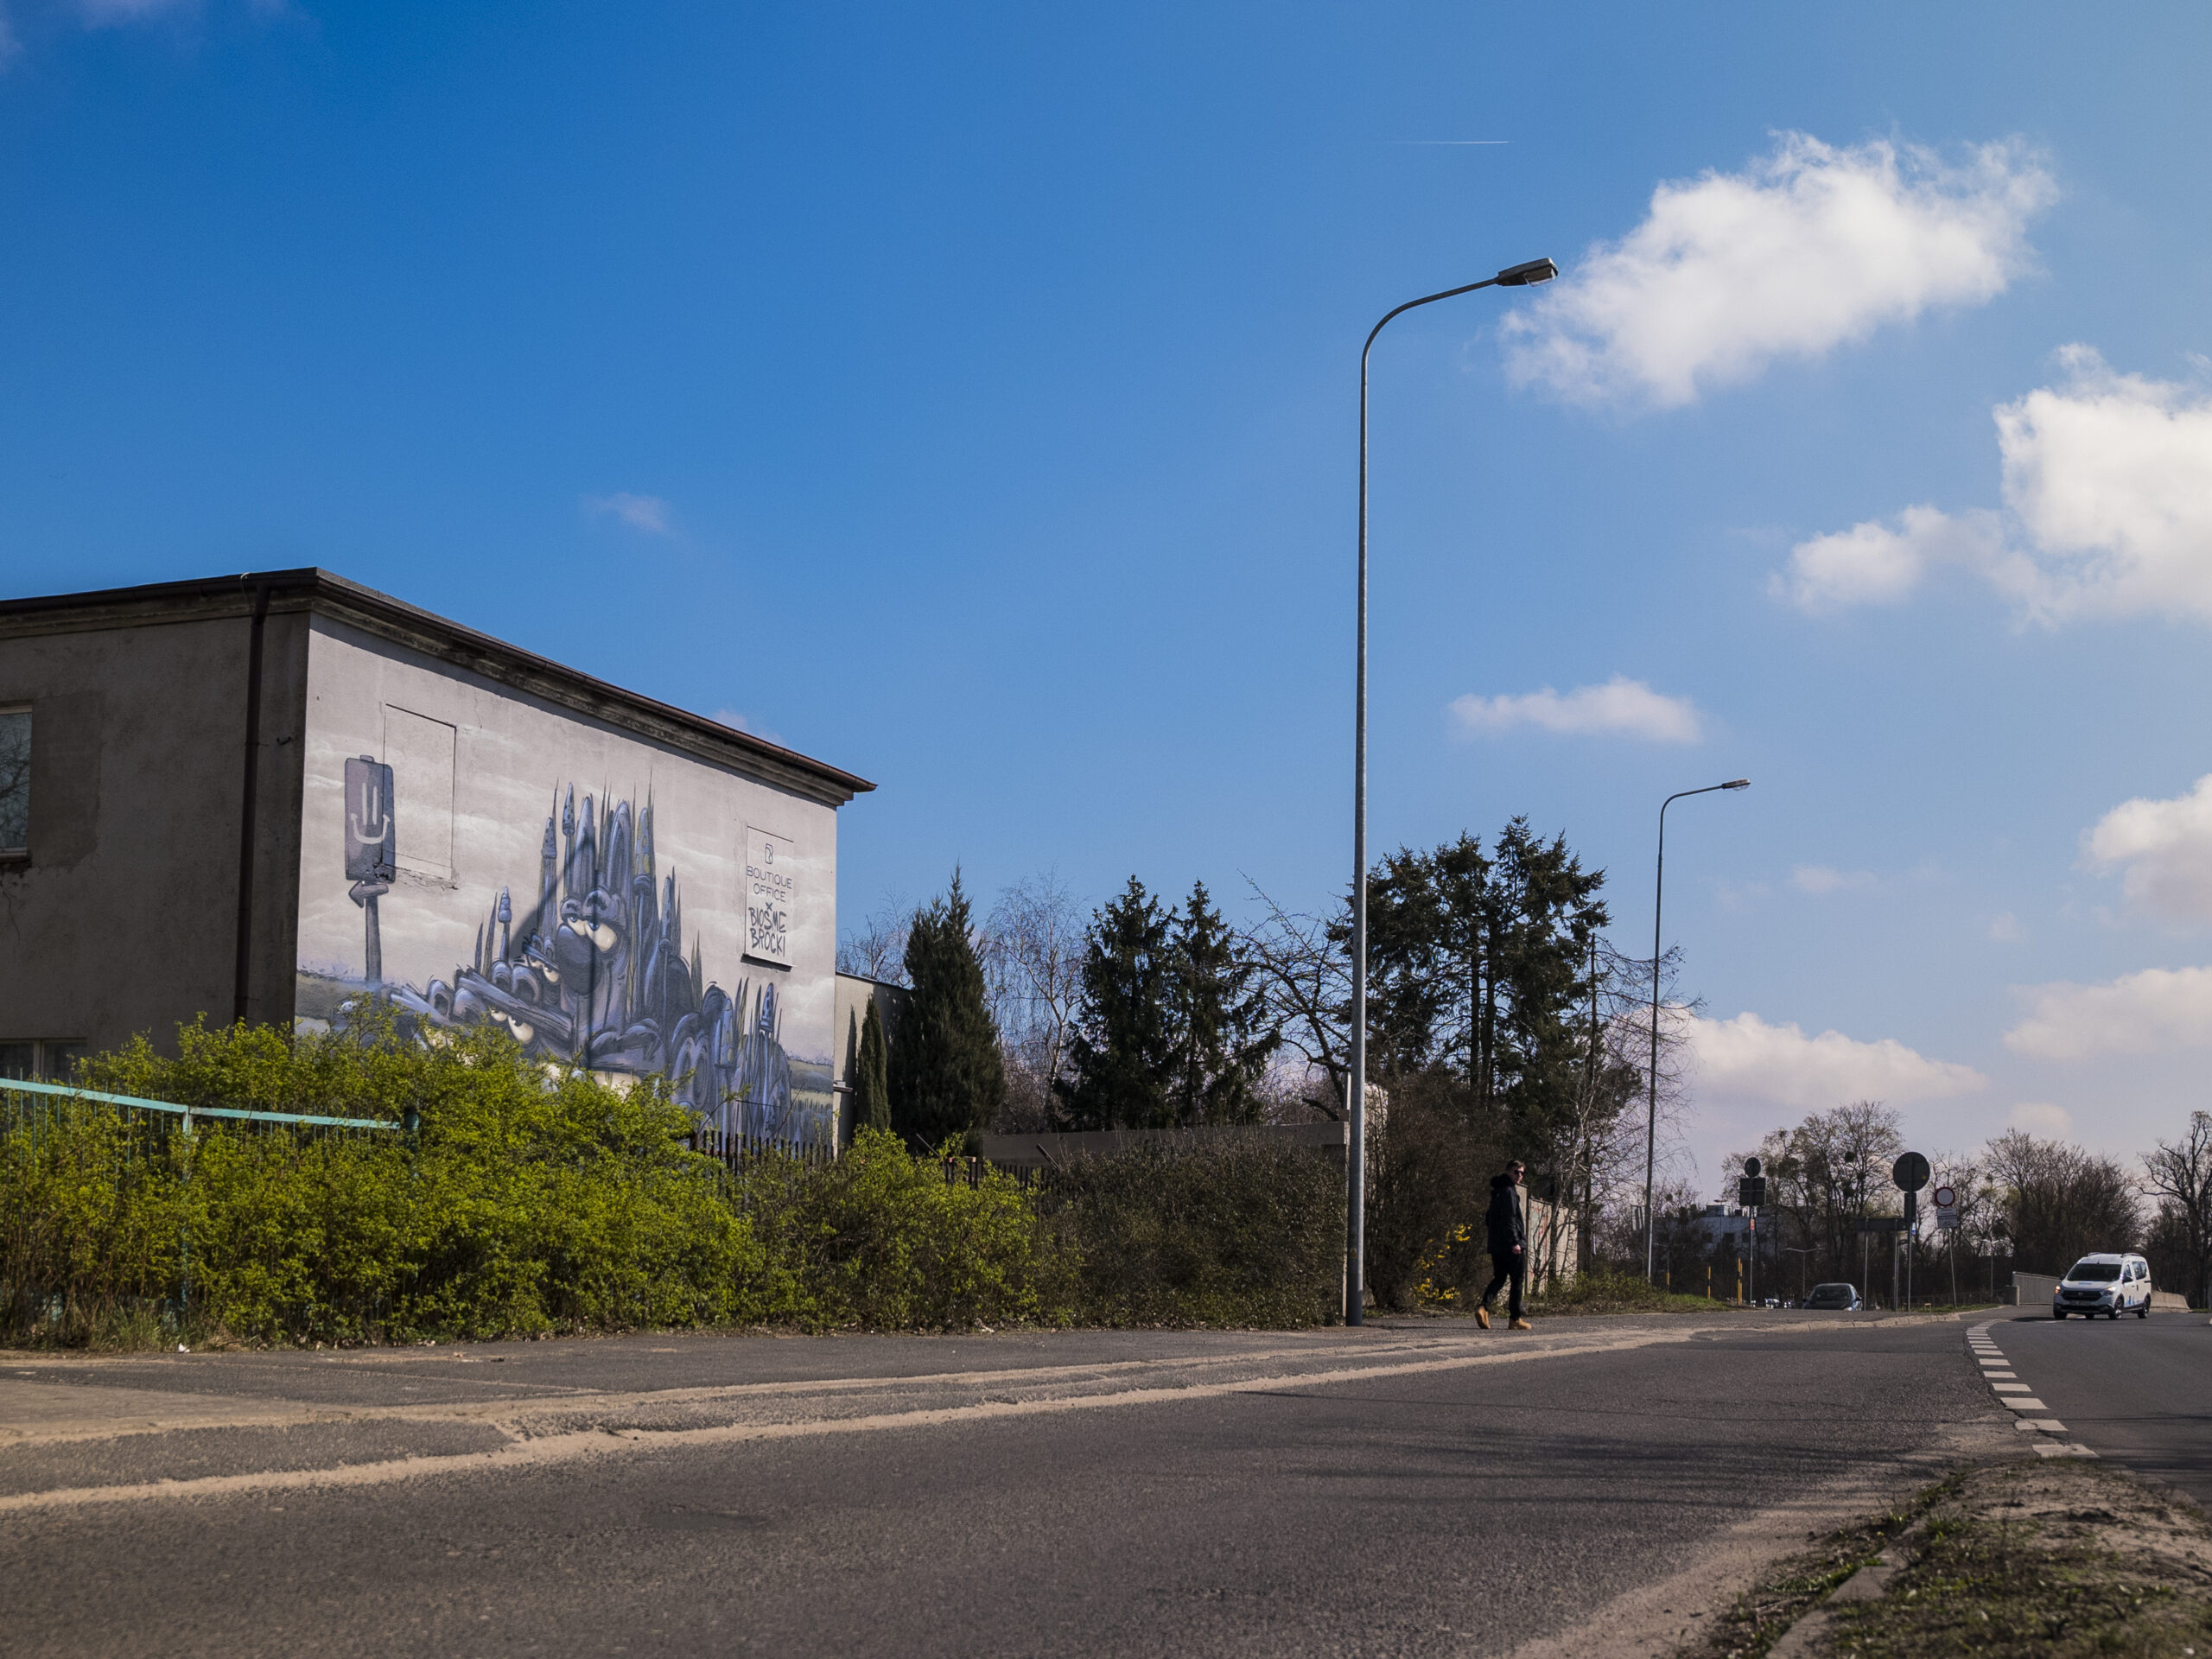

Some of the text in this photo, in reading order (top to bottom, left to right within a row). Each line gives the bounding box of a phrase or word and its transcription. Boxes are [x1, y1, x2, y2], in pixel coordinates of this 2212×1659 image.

[747, 866, 792, 889] BOUTIQUE
[753, 883, 785, 903] OFFICE
[750, 928, 785, 957] BROCKI
